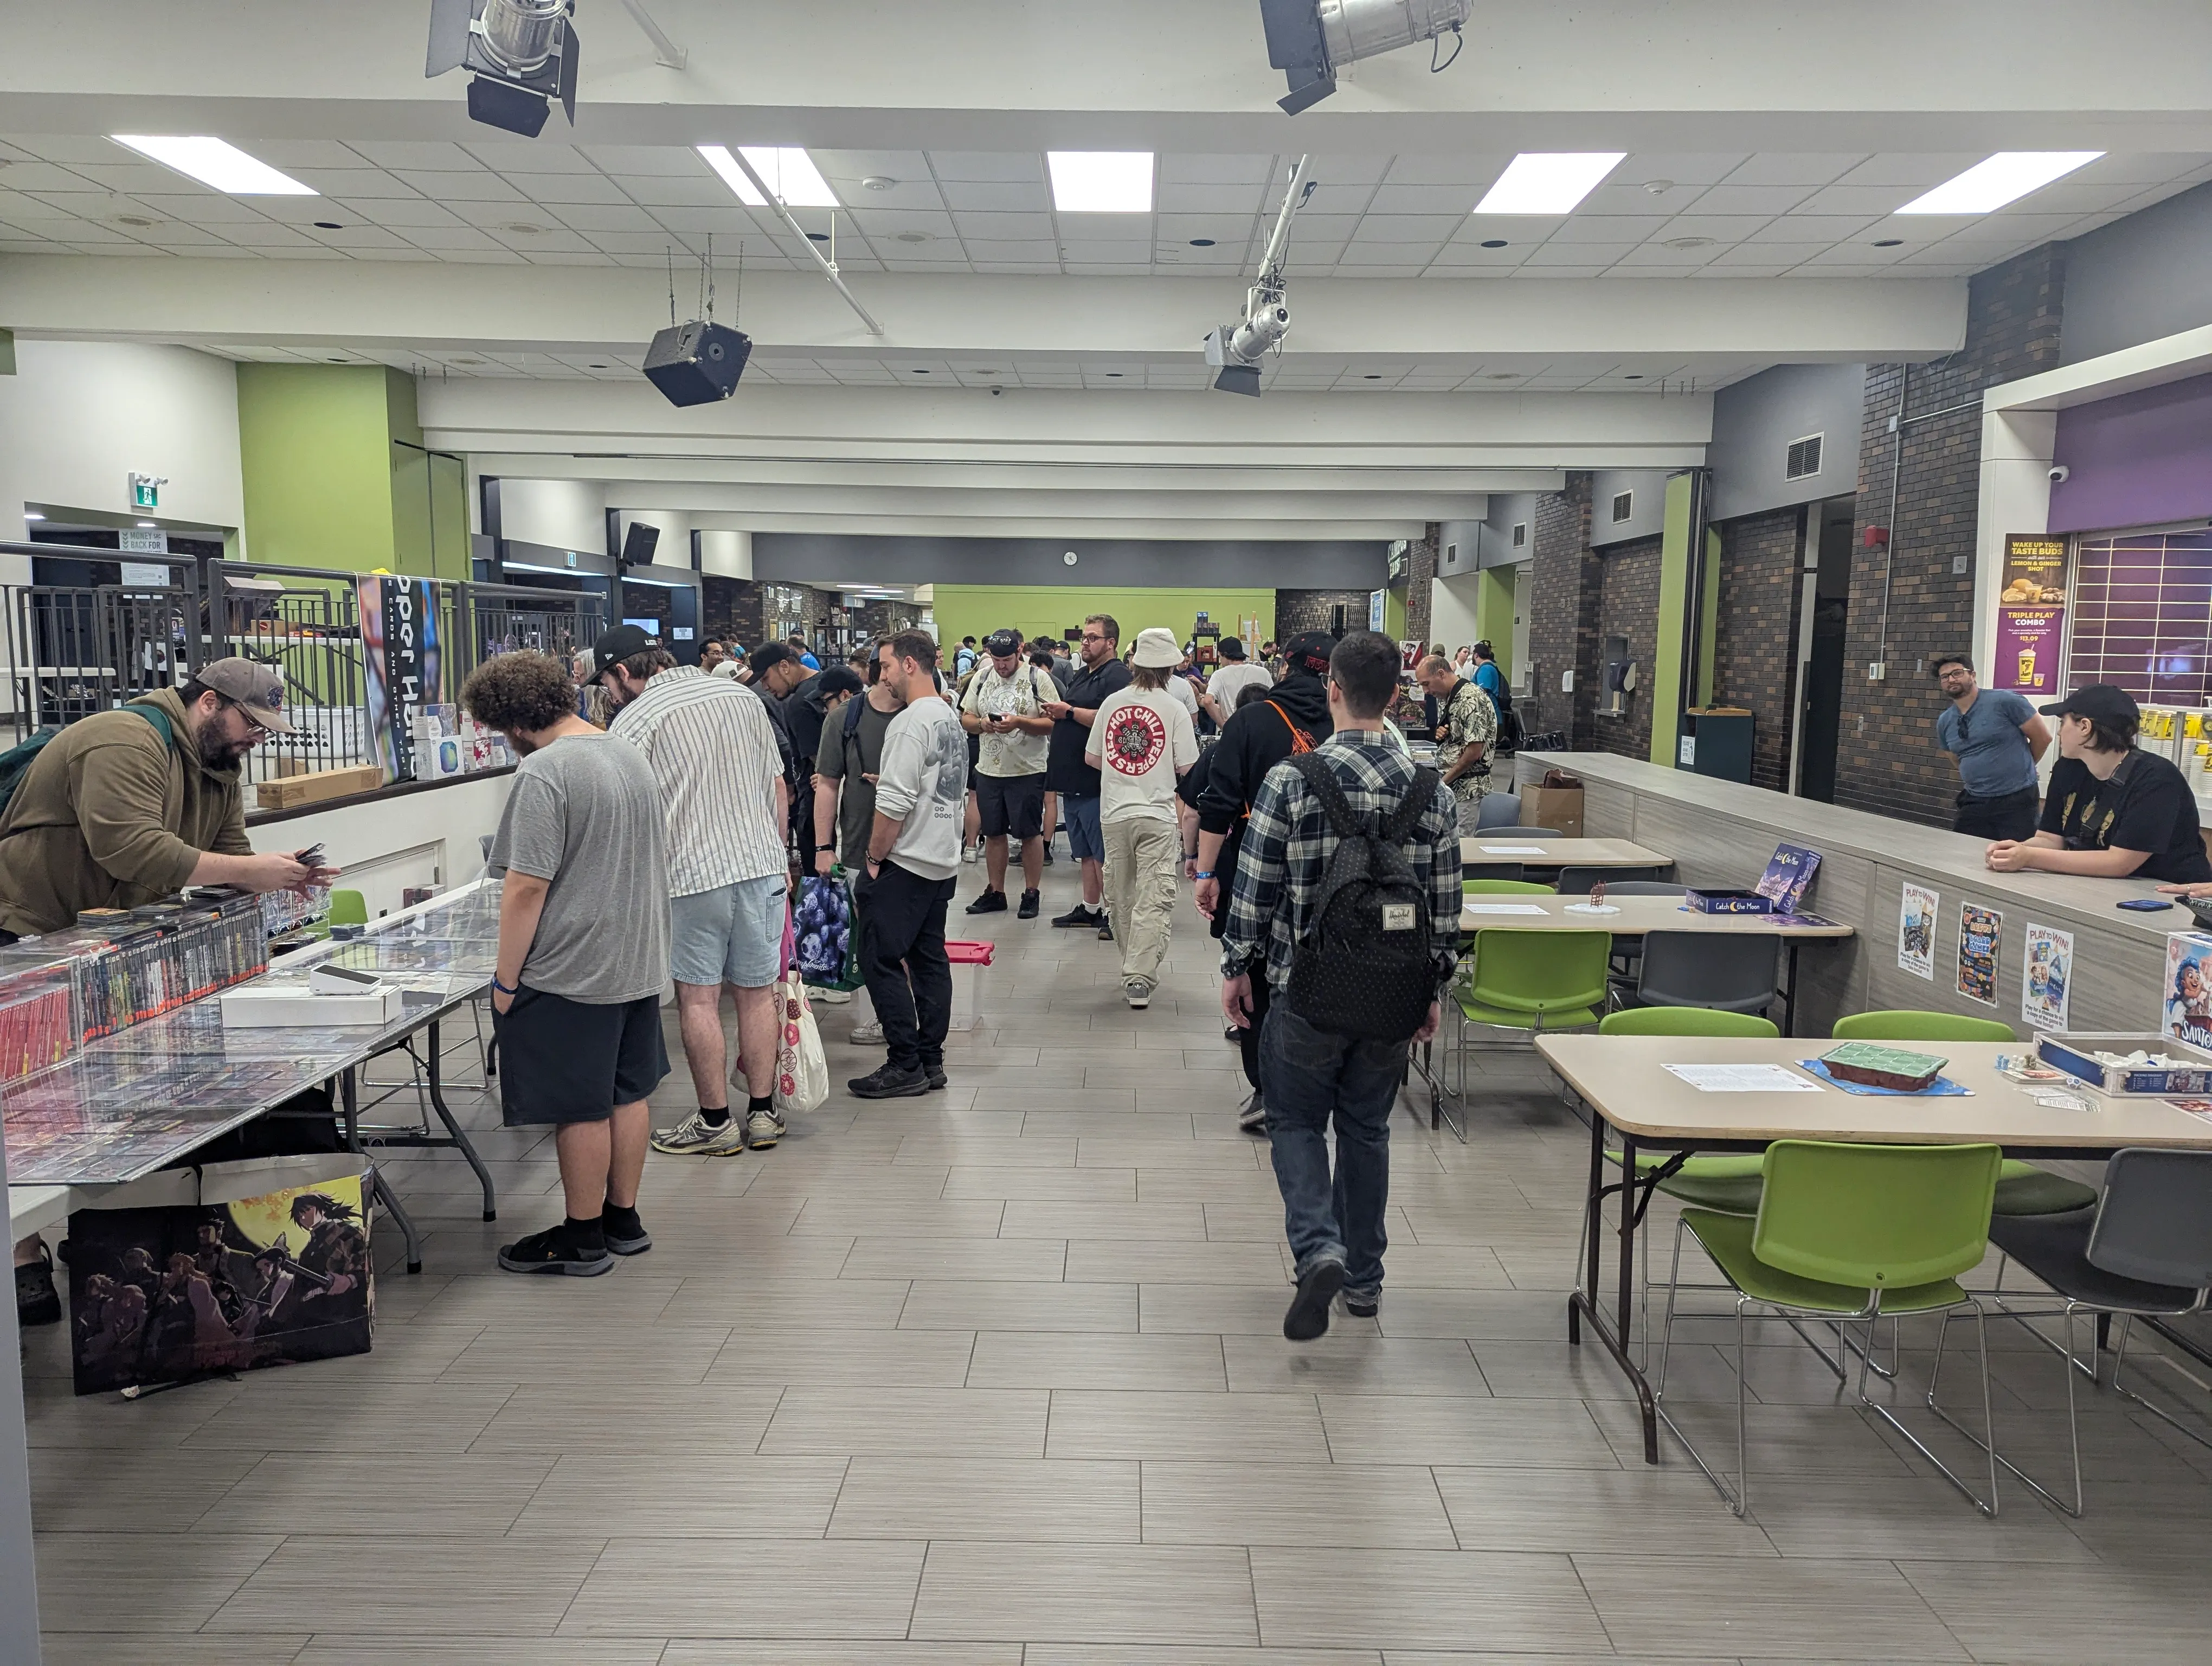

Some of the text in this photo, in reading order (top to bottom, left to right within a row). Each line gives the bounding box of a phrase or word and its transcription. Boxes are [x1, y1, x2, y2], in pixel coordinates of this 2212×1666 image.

[130, 531, 152, 540] MONEY
[1107, 708, 1163, 774] RED HOT CHILI PEPPERS
[1775, 852, 1784, 861] Catch
[1790, 856, 1799, 866] Moon
[1797, 869, 1809, 883] Moon
[1793, 882, 1803, 890] the
[1784, 895, 1795, 908] Catch
[1906, 889, 1919, 898] PLAY
[1923, 891, 1935, 907] WIN!
[1716, 902, 1729, 911] Catch
[1737, 901, 1745, 910] the
[1746, 901, 1760, 910] Moon
[1969, 934, 1991, 946] BOARD
[2030, 930, 2046, 940] PLAY
[2053, 932, 2069, 951] WIN!
[1969, 942, 1990, 954] GAMES
